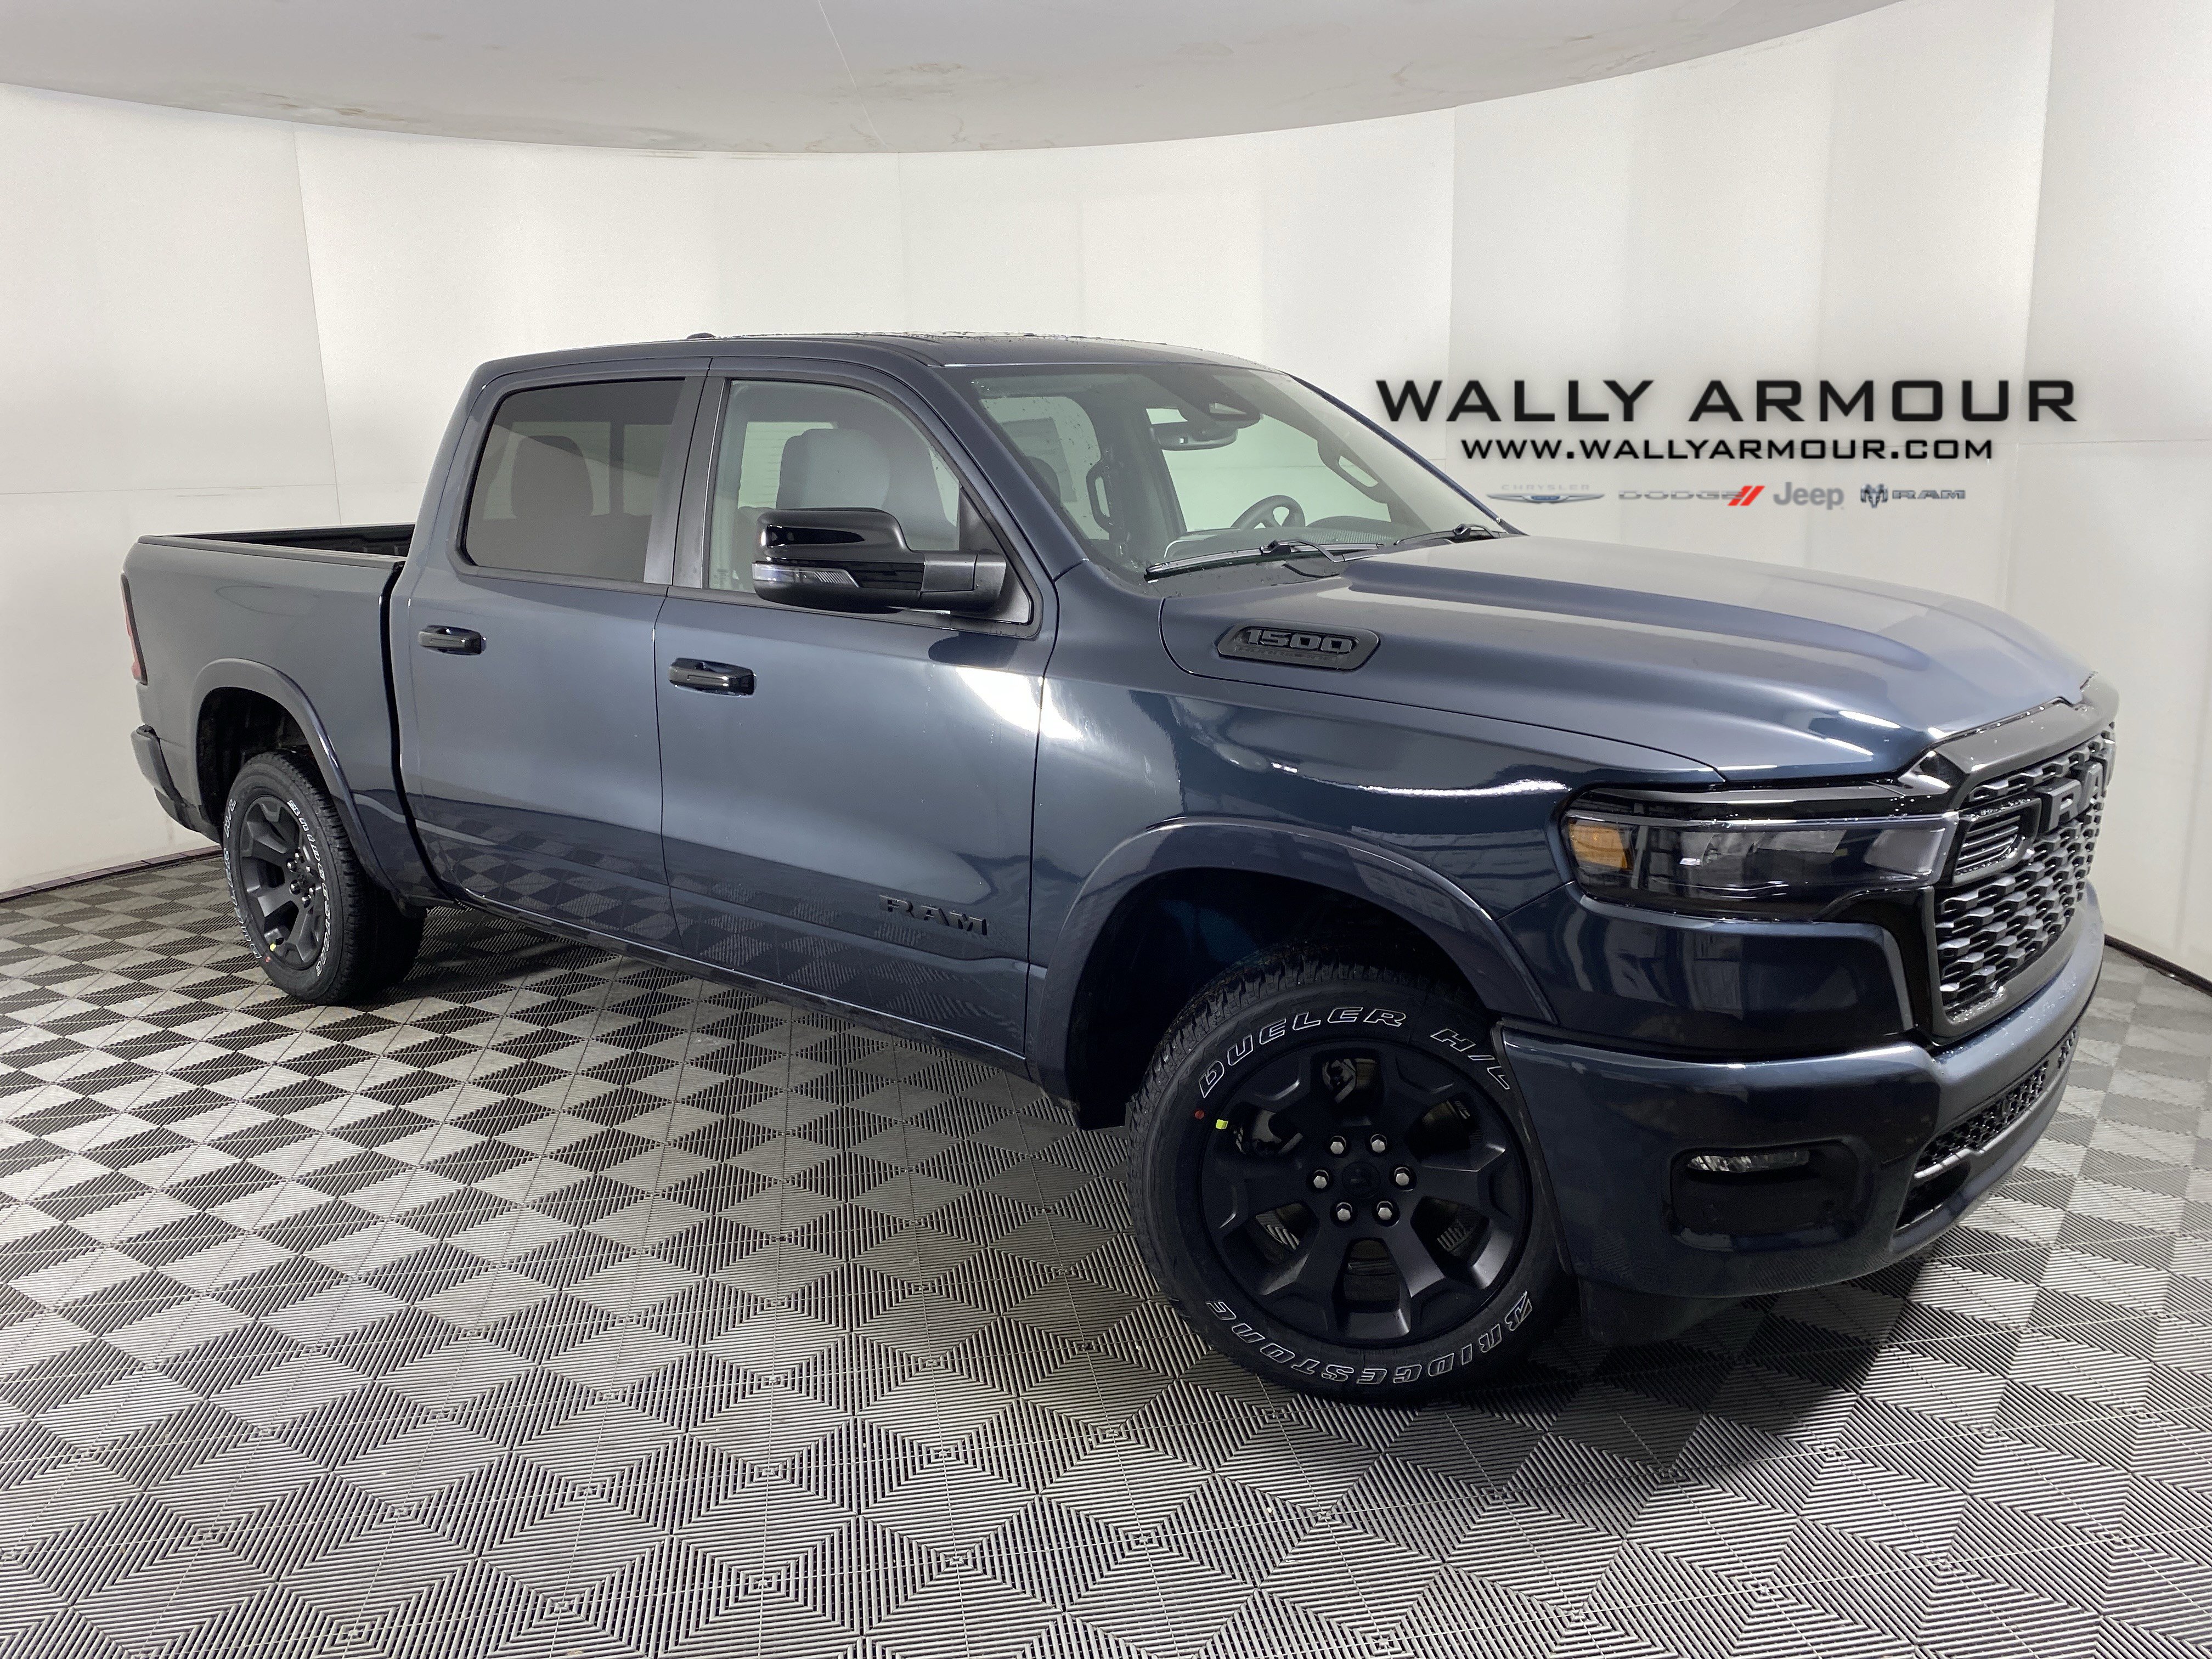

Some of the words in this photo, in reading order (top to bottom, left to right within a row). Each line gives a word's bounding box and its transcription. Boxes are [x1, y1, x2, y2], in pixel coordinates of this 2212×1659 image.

[1246, 629, 1353, 653] 1500
[2033, 738, 2116, 832] RA
[879, 895, 988, 936] RAM
[1198, 1007, 1407, 1099] DUELER
[1430, 1028, 1510, 1090] H/L
[1206, 1290, 1532, 1386] BRIDGESTONE
